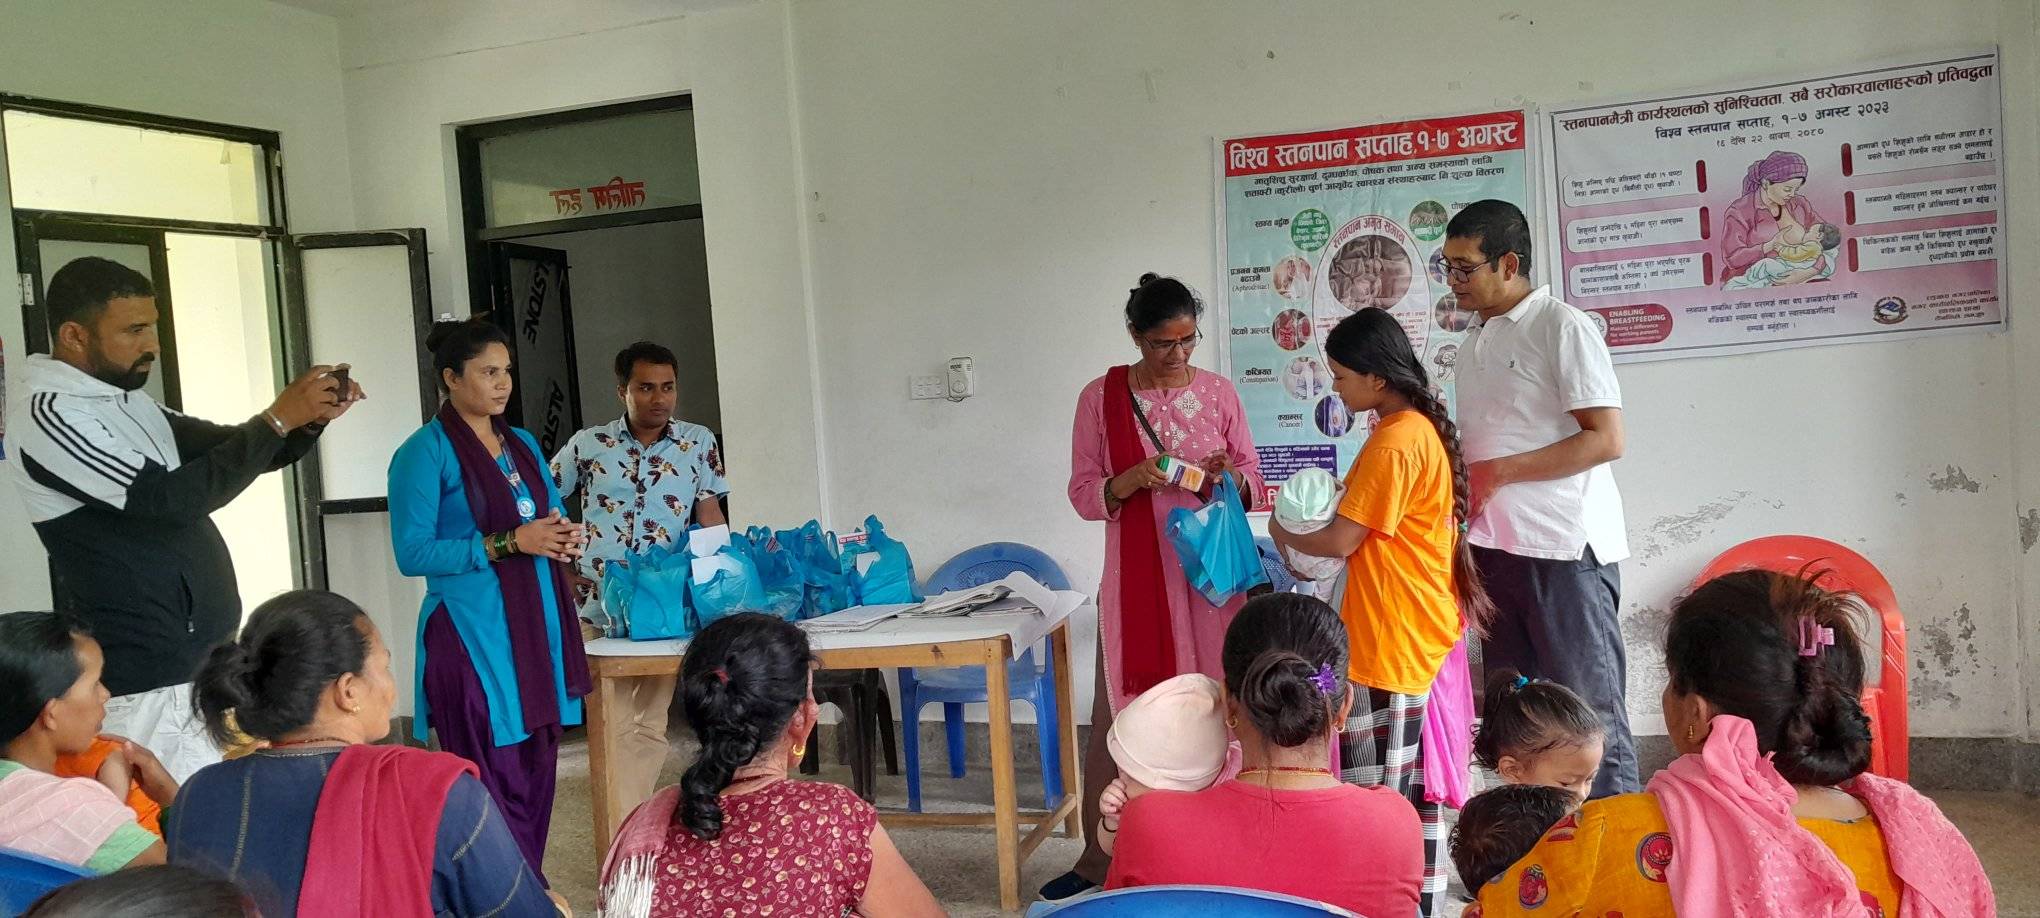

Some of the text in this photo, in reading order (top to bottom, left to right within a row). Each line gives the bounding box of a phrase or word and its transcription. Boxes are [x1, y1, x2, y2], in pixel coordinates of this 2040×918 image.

[1637, 100, 1709, 122] कार्यस्थलको
[1789, 86, 1809, 104] सबै
[1655, 126, 1682, 140] विश्व
[1687, 121, 1731, 137] स्तनपान
[1737, 115, 1775, 130] सप्ताह,
[1815, 105, 1851, 120] अगस्ट
[1857, 101, 1890, 117] २०२३
[1229, 142, 1269, 170] विश्व
[1275, 139, 1349, 167] स्तनपान
[1417, 129, 1450, 151] १-७
[1457, 121, 1519, 148] अगस्ट
[1716, 138, 1726, 148] १६
[1730, 134, 1746, 146] देखि
[1751, 134, 1763, 143] २२
[1797, 126, 1825, 138] २०८०
[1362, 163, 1384, 175] पोषक
[1387, 164, 1403, 174] तथा
[1406, 161, 1426, 172] अन्य
[1428, 156, 1469, 170] समस्याको
[1471, 155, 1493, 165] लागि
[1475, 167, 1505, 178] वितरण
[1333, 218, 1361, 248] स्तनपान
[1363, 217, 1382, 231] अमृत
[1609, 308, 1645, 318] ENABLING
[1609, 314, 1666, 325] BREASTFEEDING
[1609, 325, 1629, 333] Making
